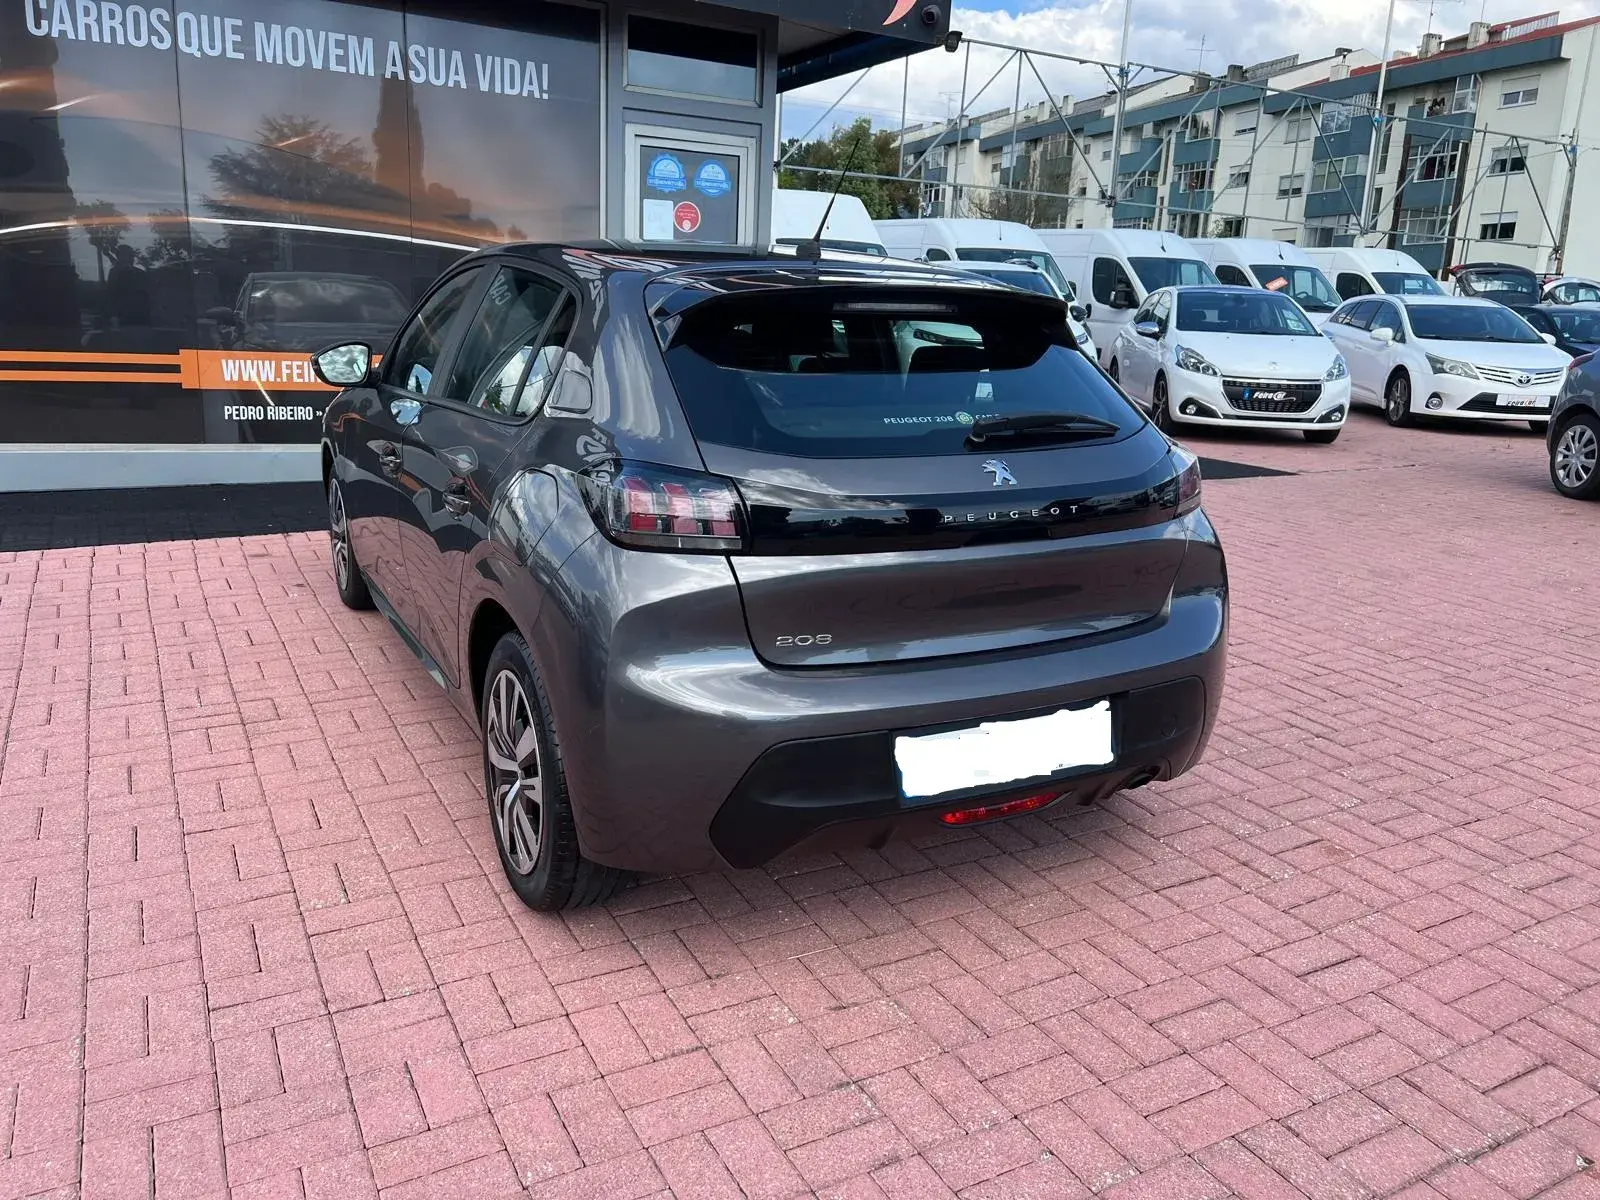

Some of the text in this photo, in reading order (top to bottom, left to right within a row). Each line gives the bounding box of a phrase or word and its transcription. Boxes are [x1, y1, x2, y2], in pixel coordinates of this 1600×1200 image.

[24, 0, 172, 50] CARROS
[177, 11, 245, 59] QUE
[254, 21, 375, 77] MOVEM
[408, 44, 467, 89] SUA
[475, 53, 549, 100] VIDA!
[224, 405, 264, 420] PEDRO
[267, 405, 314, 421] RIBEIRO
[883, 416, 933, 424] PEUGEOT
[936, 415, 954, 423] 208
[944, 505, 1078, 523] PEUGEOT
[775, 634, 833, 647] 208
